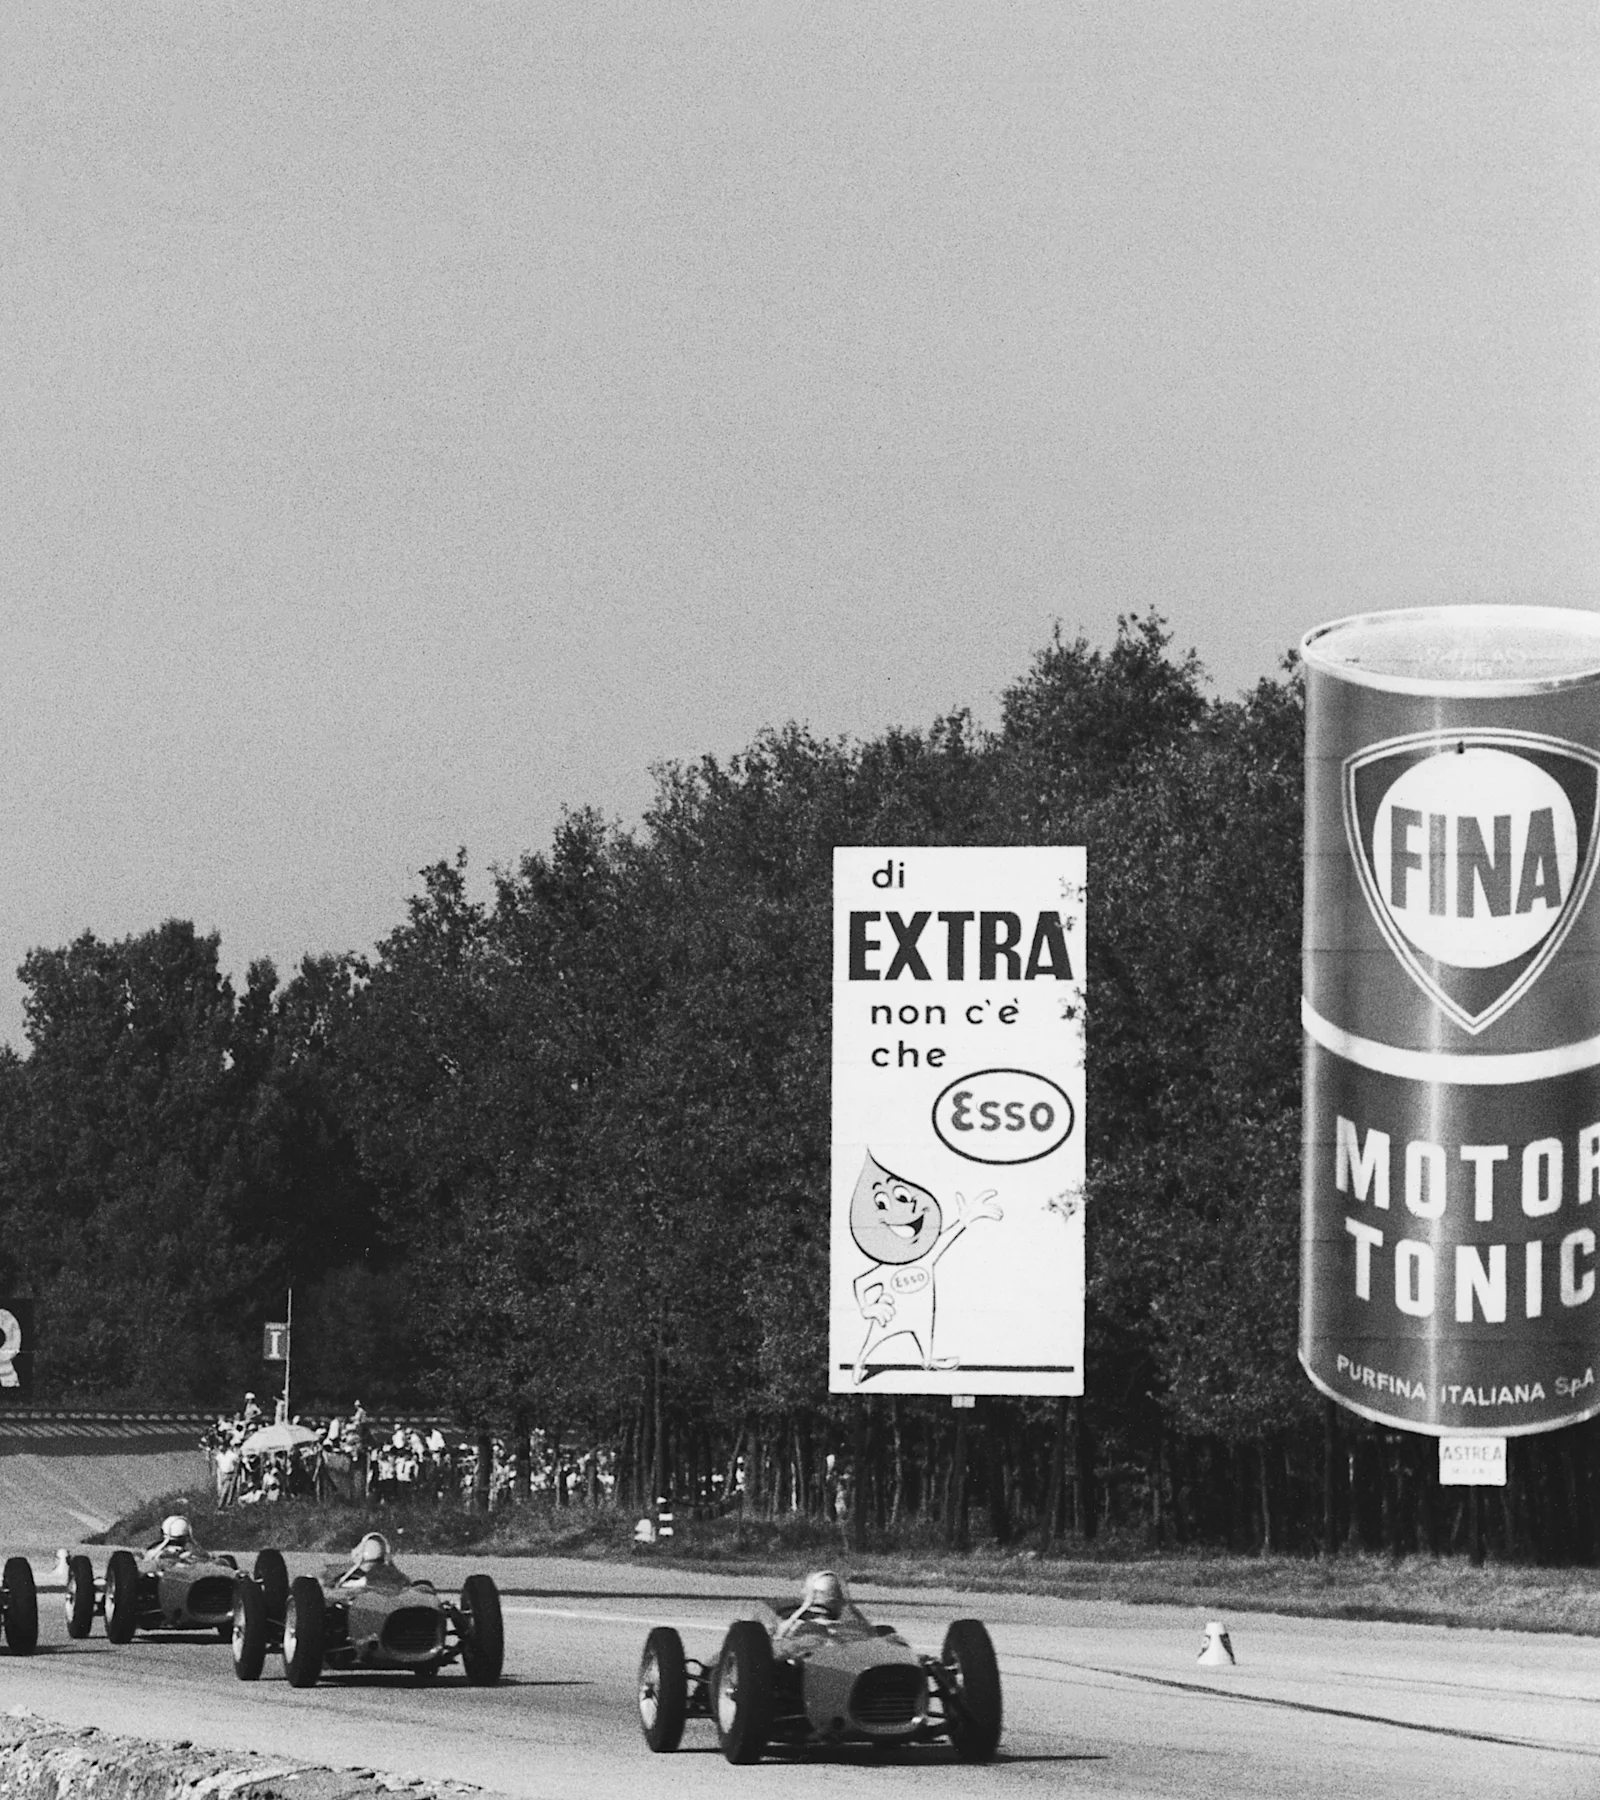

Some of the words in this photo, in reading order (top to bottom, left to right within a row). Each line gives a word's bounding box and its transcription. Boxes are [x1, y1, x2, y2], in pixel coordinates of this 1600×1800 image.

[871, 859, 905, 889] di
[1391, 806, 1562, 918] FINA
[848, 910, 1074, 981] EXTRA
[871, 1004, 946, 1025] non
[871, 1039, 946, 1068] che
[1345, 1216, 1596, 1324] TONIC
[1337, 1354, 1427, 1400] PURFINA
[1441, 1383, 1546, 1407] ITALIANA
[1443, 1446, 1503, 1461] ASTREA
